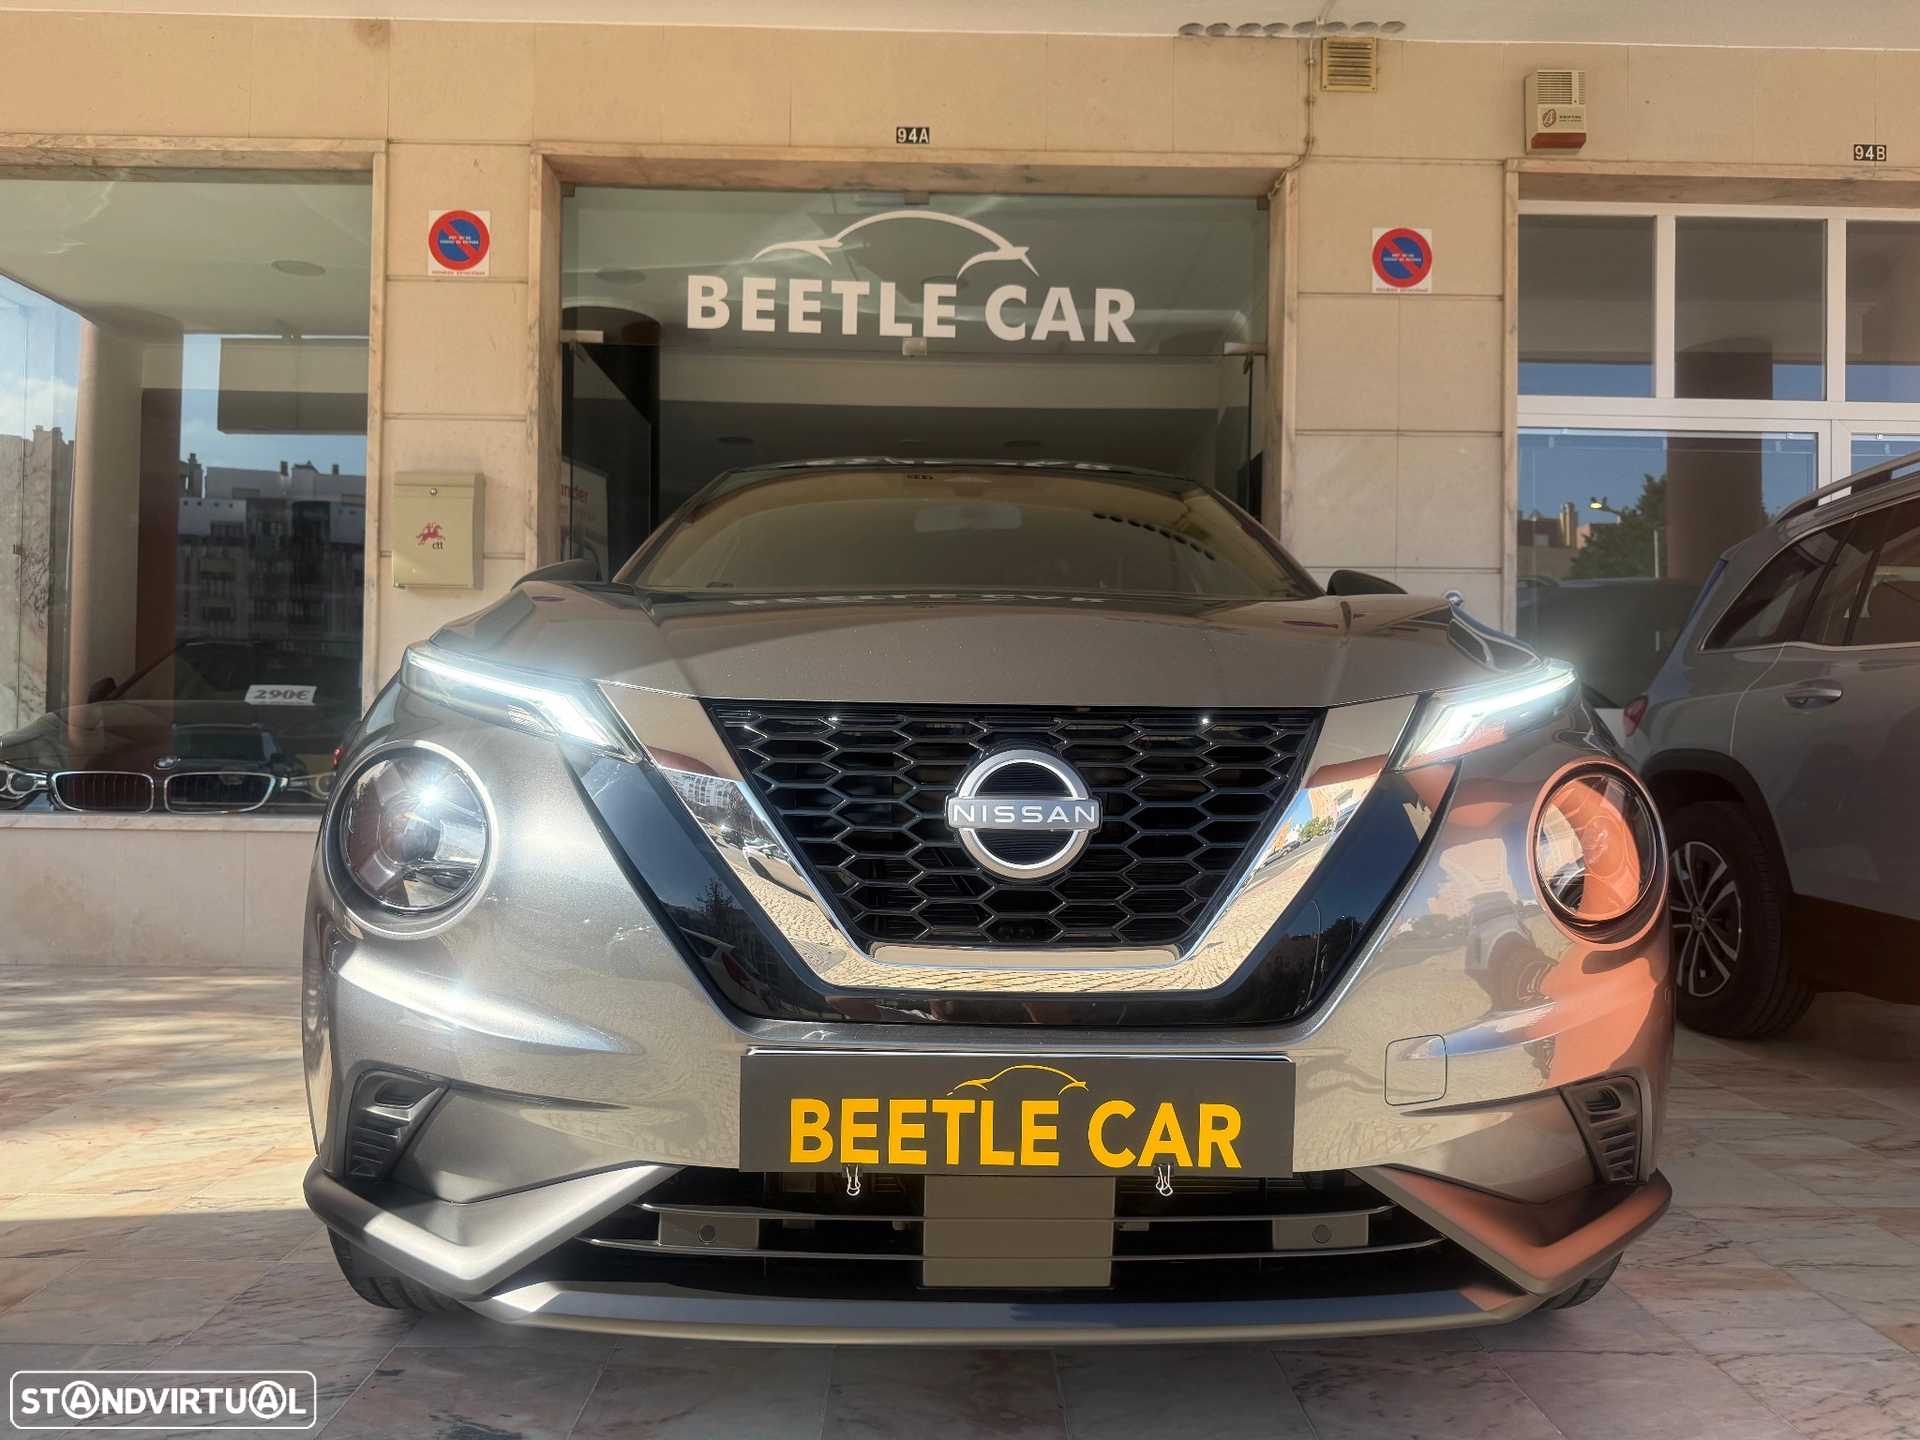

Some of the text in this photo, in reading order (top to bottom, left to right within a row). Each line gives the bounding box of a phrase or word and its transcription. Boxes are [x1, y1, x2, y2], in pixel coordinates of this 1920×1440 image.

[897, 128, 929, 143] 94A
[1855, 145, 1886, 160] 94B
[687, 275, 1136, 343] BEETLE CAR
[432, 541, 443, 550] ctt
[253, 689, 310, 700] 290€
[953, 805, 1095, 823] NISSAN
[789, 1098, 1242, 1168] BEETLE CAR
